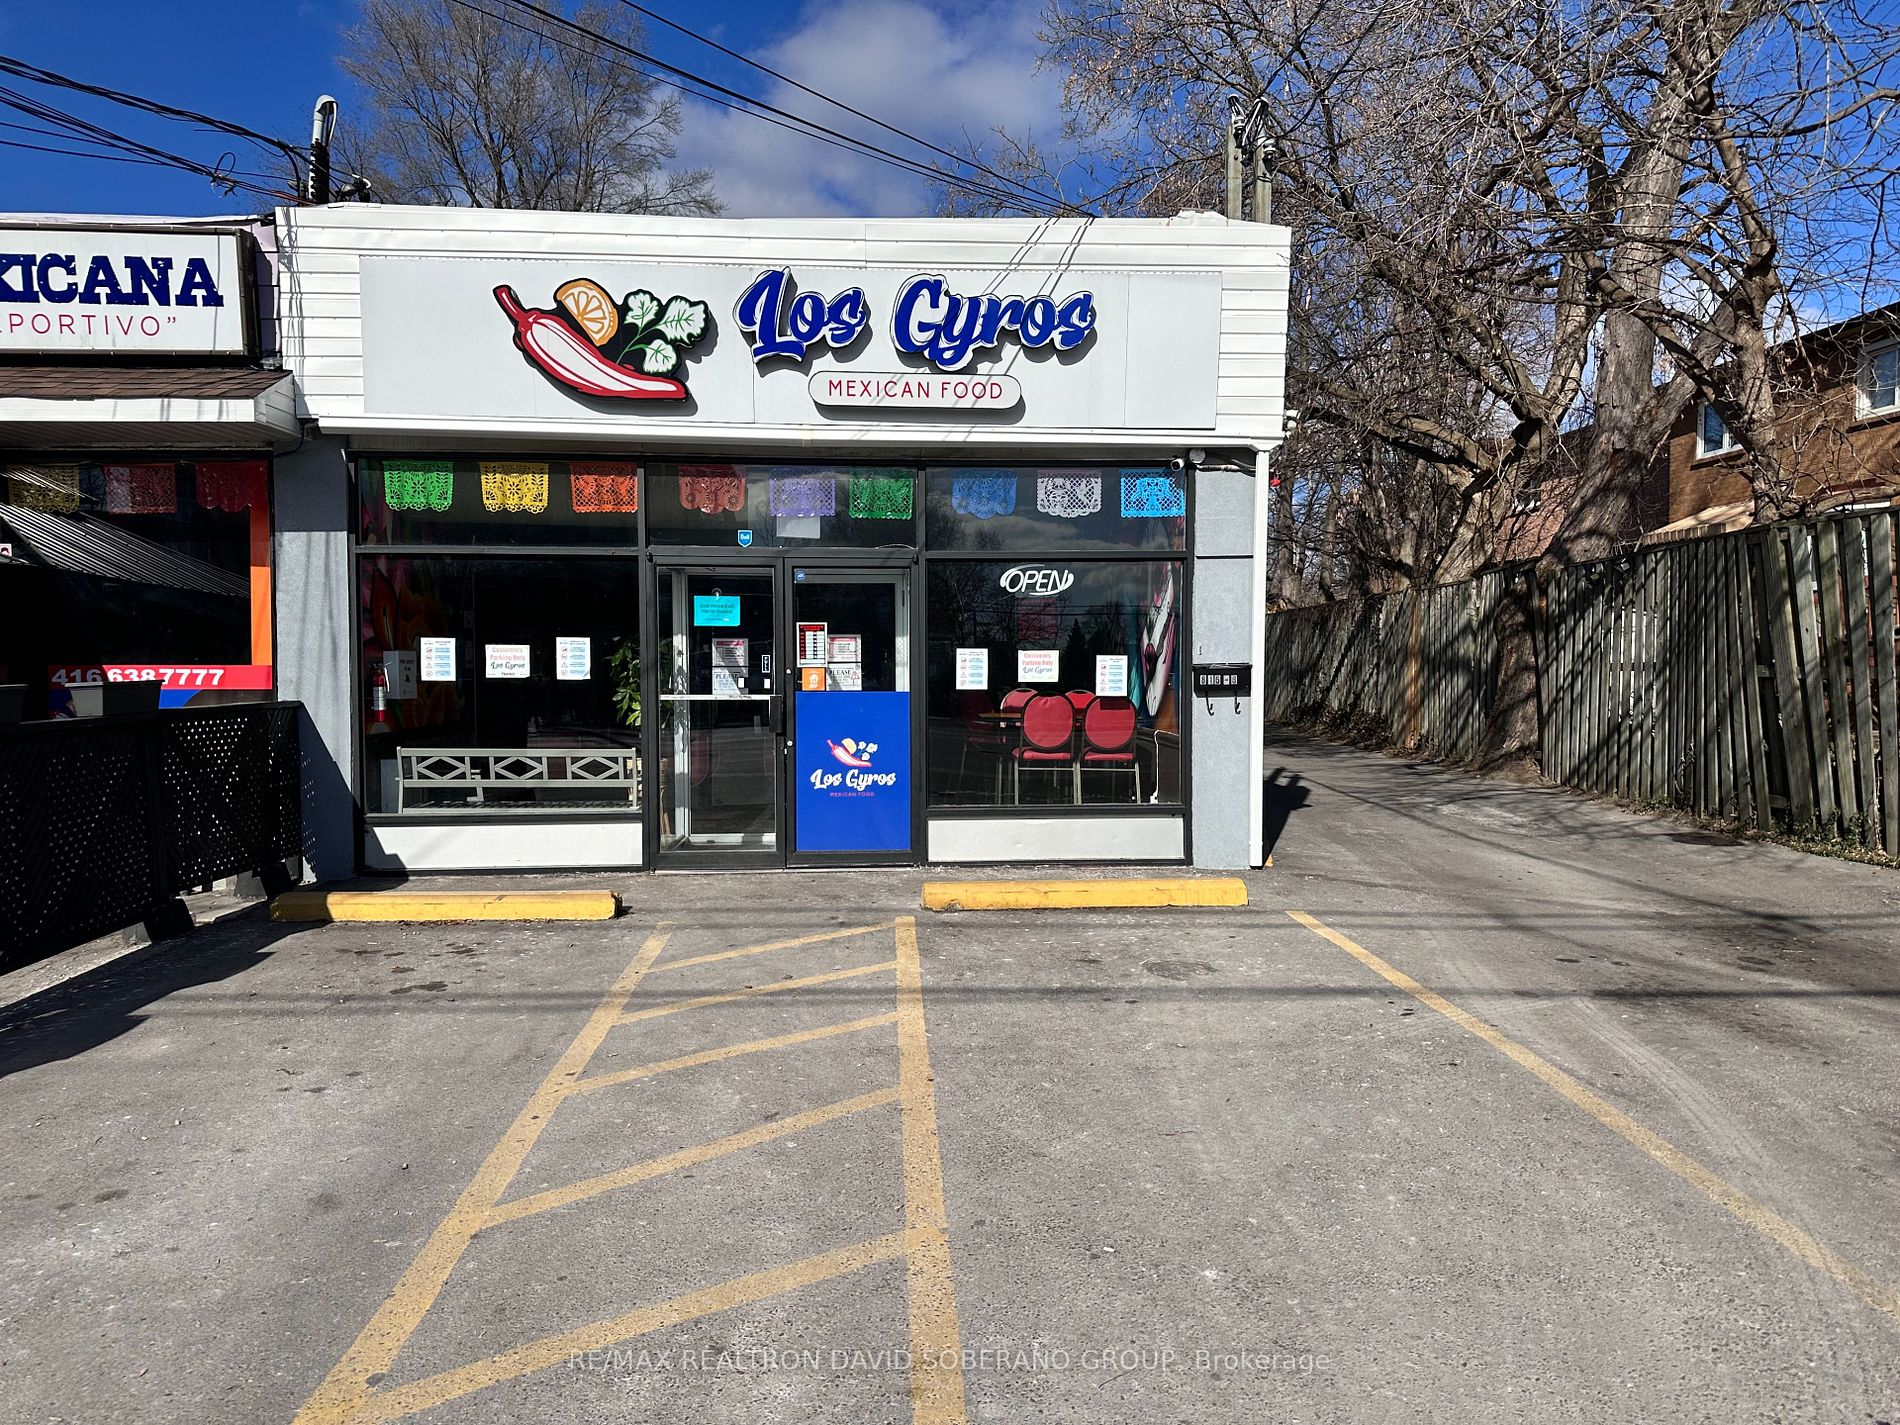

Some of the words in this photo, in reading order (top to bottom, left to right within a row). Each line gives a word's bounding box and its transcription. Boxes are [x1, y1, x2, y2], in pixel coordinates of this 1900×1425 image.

[0, 313, 176, 336] PORTIVO”
[733, 266, 868, 362] Los
[892, 273, 1096, 371] Gyros
[828, 379, 930, 400] MEXICAN
[941, 380, 1003, 400] FOOD
[1005, 570, 1068, 593] OPEN
[490, 661, 503, 669] Los
[504, 661, 525, 670] Gyros
[810, 768, 843, 790] Los
[845, 768, 897, 791] Gyros
